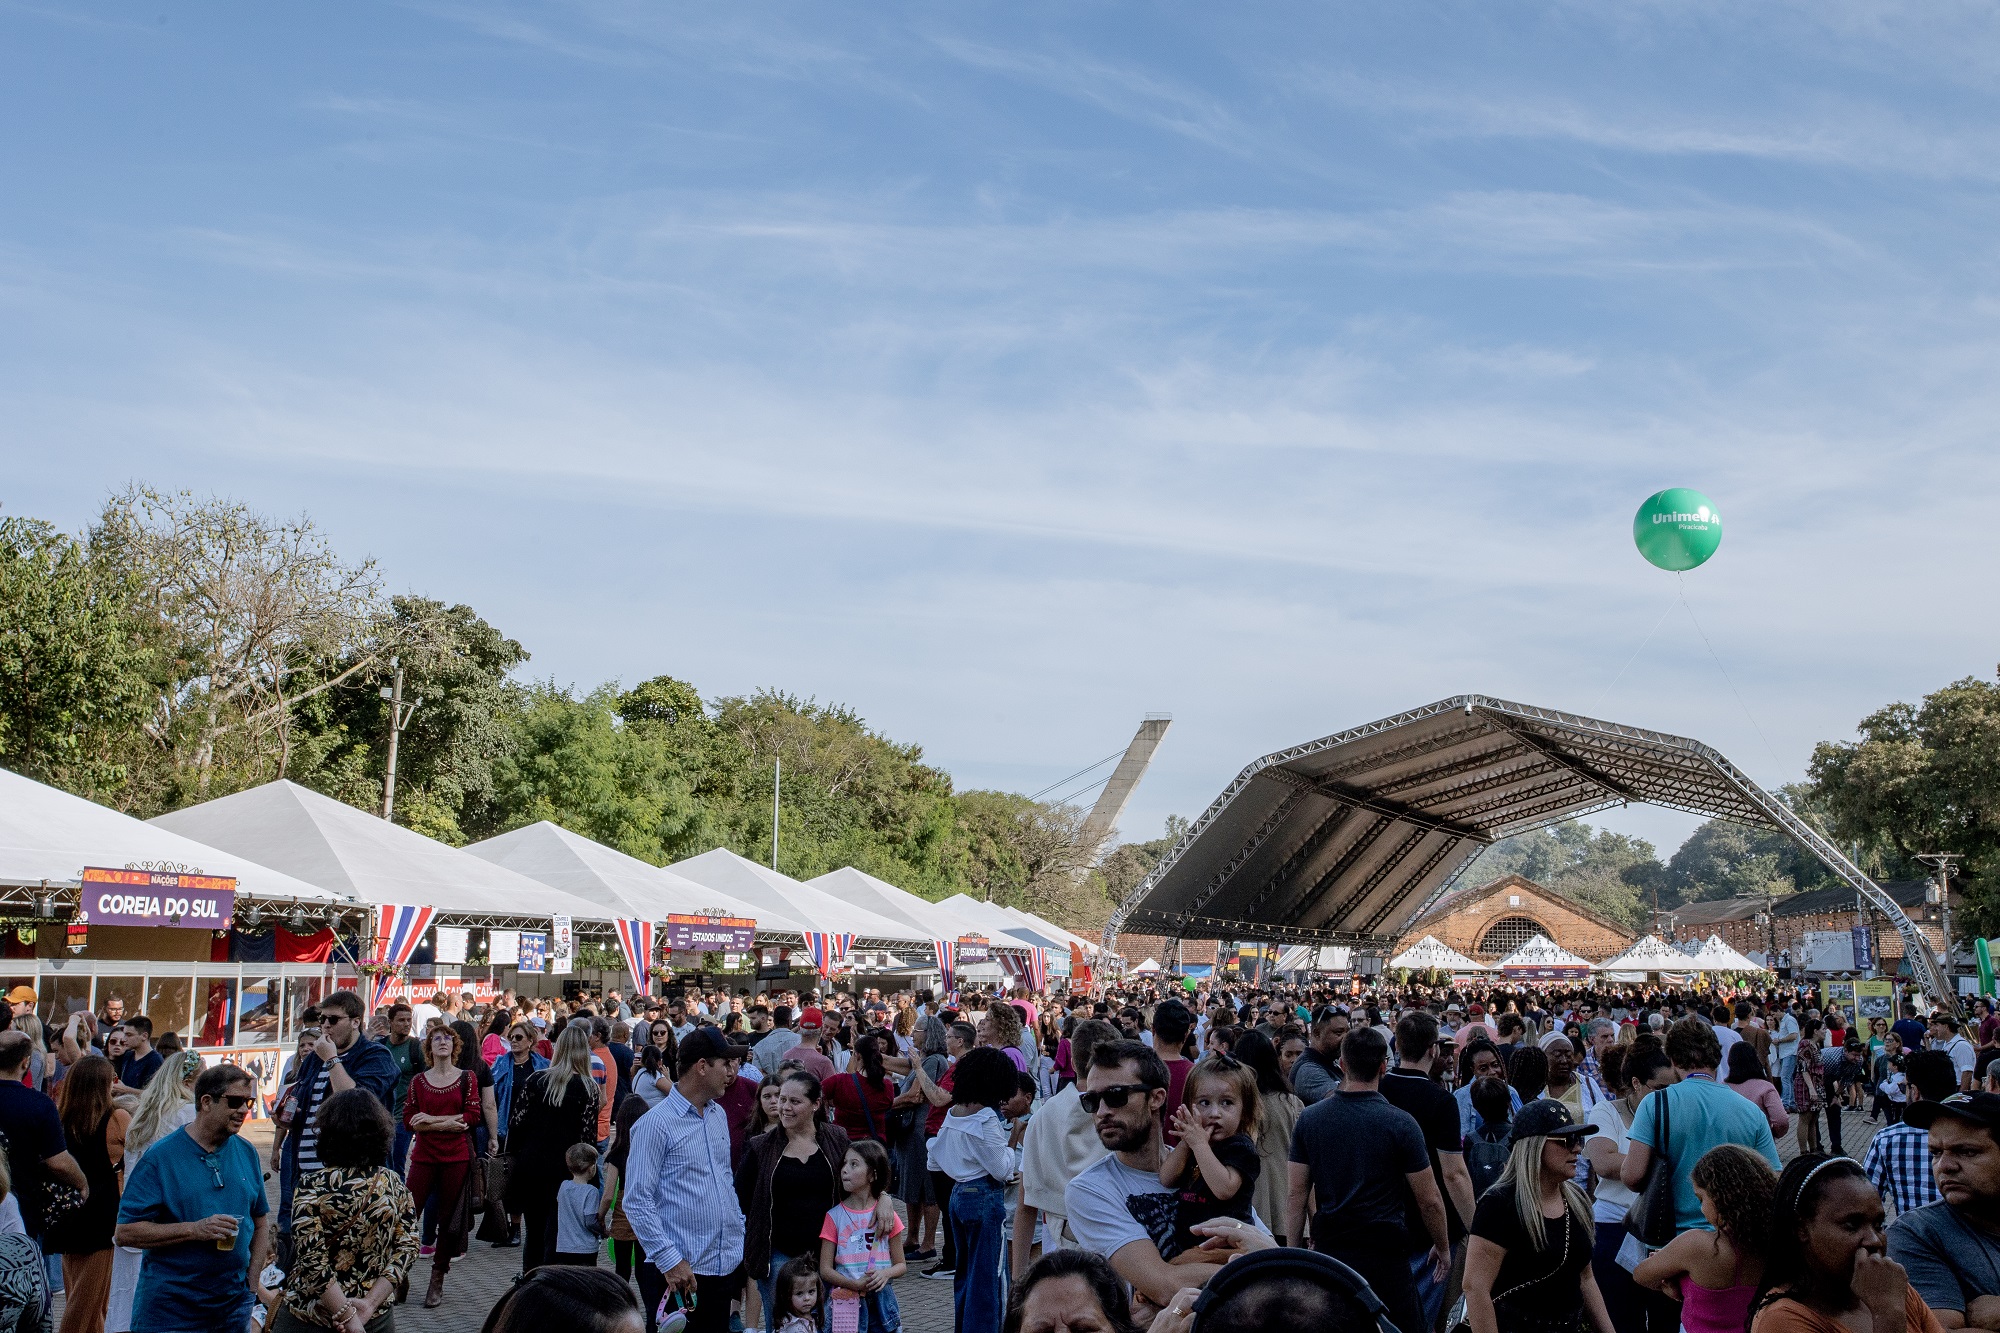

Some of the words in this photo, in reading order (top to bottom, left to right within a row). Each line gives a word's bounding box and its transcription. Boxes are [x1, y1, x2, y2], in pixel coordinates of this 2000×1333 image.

[150, 874, 178, 886] NAÇÕES
[99, 893, 161, 916] COREIA
[164, 897, 188, 917] DO
[191, 899, 220, 918] SUL
[691, 931, 715, 942] ESTADOS
[715, 933, 734, 943] UNIDOS
[960, 947, 976, 957] ESTADOS
[976, 947, 988, 957] UNIDOS
[411, 986, 438, 998] CAIXA
